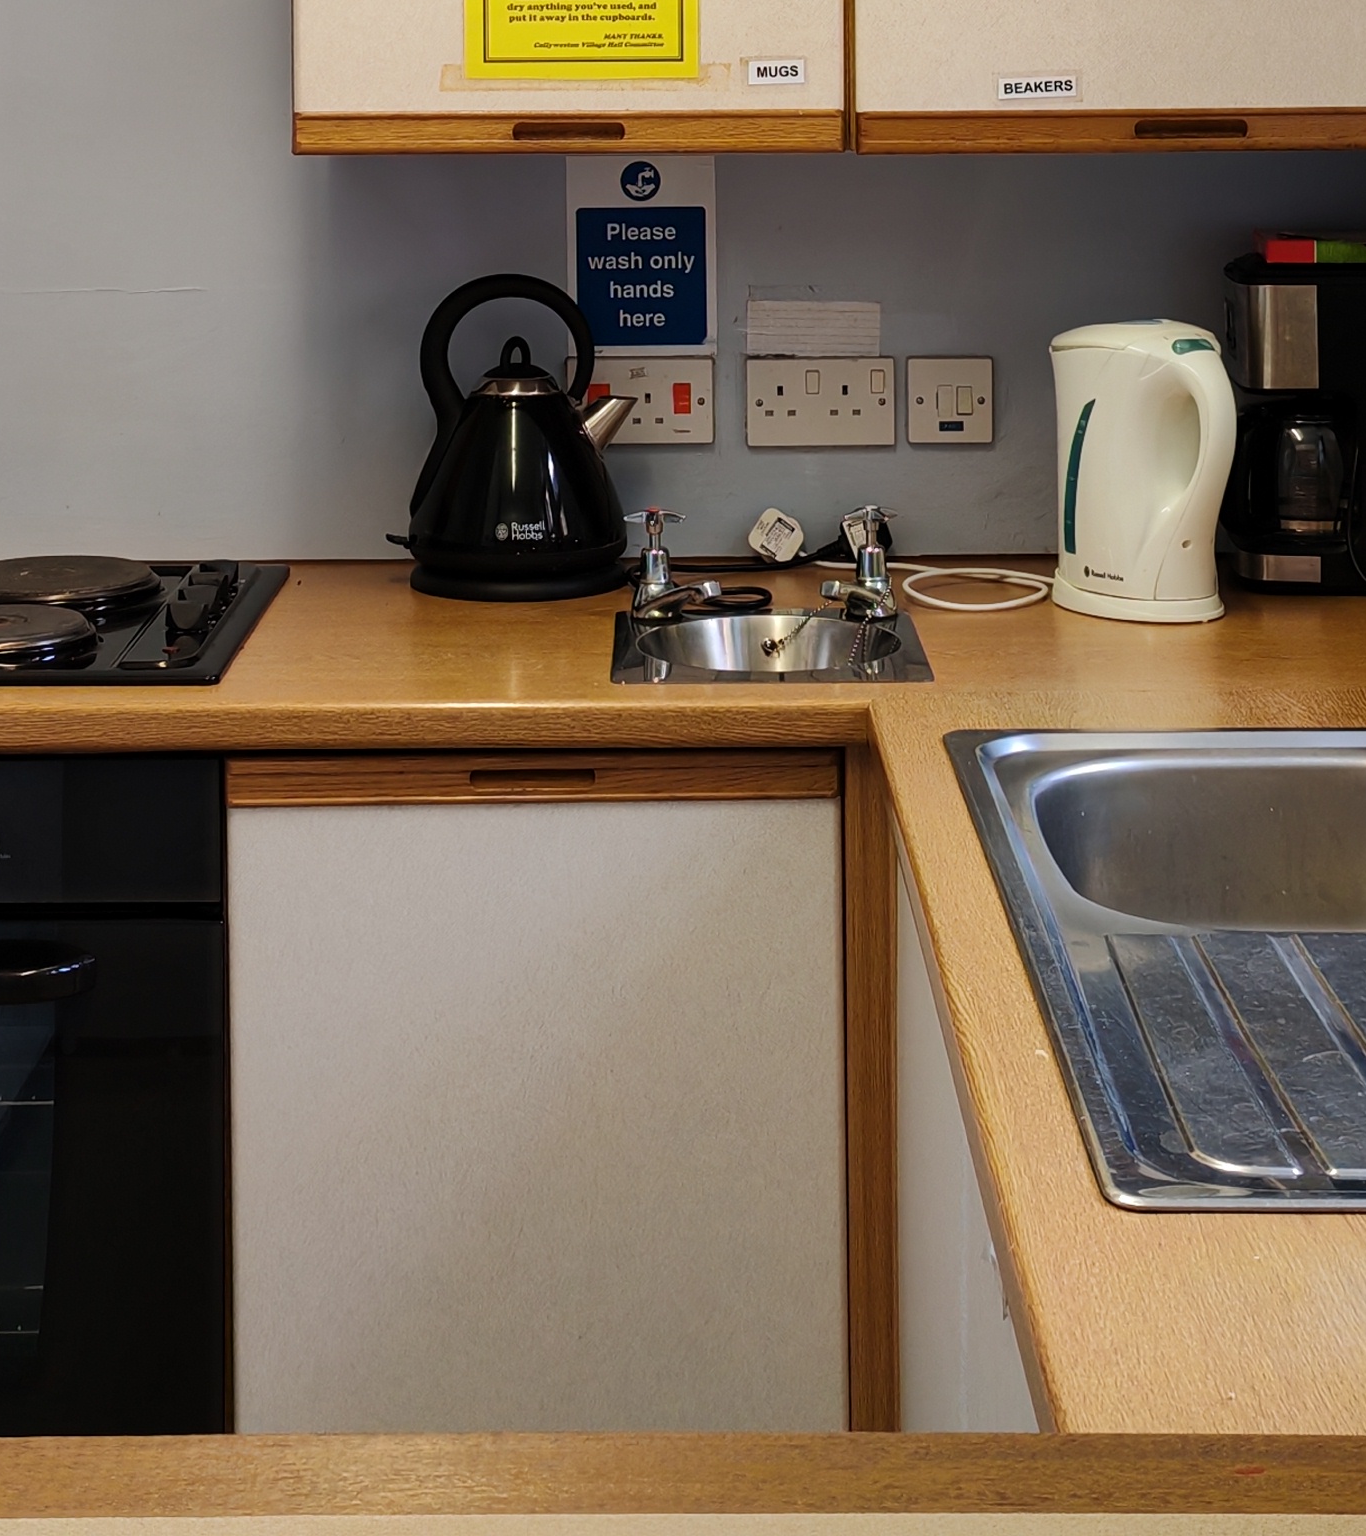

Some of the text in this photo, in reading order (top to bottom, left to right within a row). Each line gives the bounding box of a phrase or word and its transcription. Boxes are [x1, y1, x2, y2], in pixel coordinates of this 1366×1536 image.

[507, 1, 657, 12] dry anything you've used, and
[509, 13, 656, 23] put it away in the cupboards.
[756, 64, 799, 78] MUGS
[1003, 79, 1073, 95] BEAKERS
[606, 223, 677, 241] Please
[587, 251, 695, 274] wash only
[609, 280, 675, 299] hands
[619, 309, 666, 328] here
[511, 519, 546, 531] Russell
[511, 530, 544, 541] Hobbs
